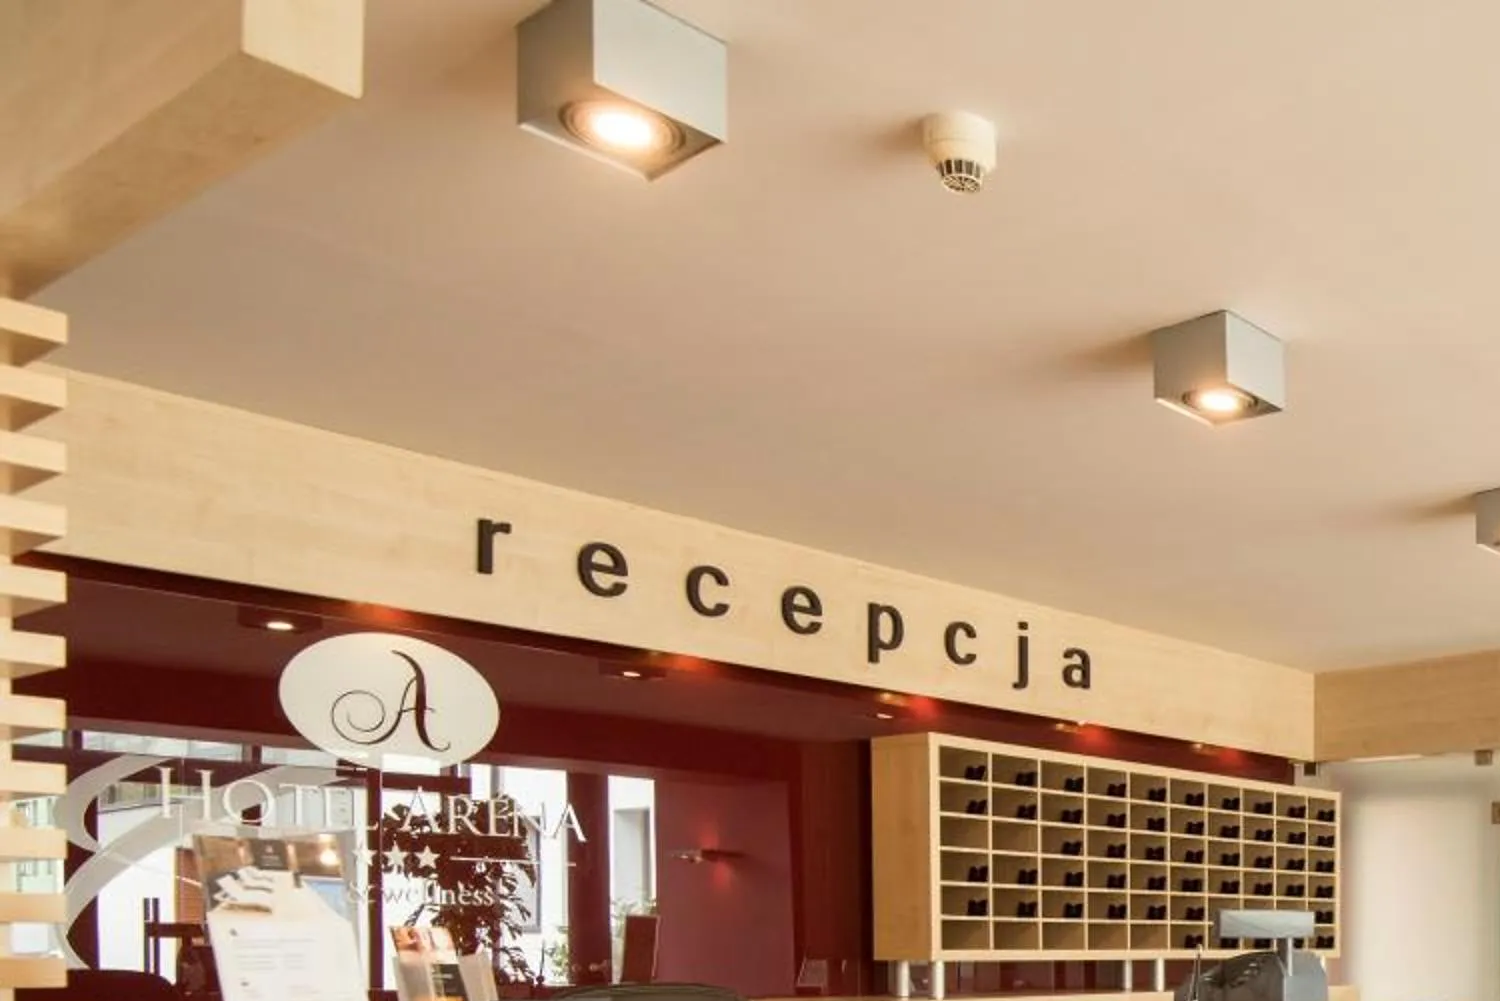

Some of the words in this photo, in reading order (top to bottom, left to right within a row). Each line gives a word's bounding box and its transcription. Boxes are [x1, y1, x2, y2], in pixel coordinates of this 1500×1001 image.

[476, 516, 1092, 689] recepcja
[331, 649, 452, 752] A
[157, 766, 379, 831] HOTEL
[400, 786, 588, 843] ARENA
[384, 878, 495, 906] wellness
